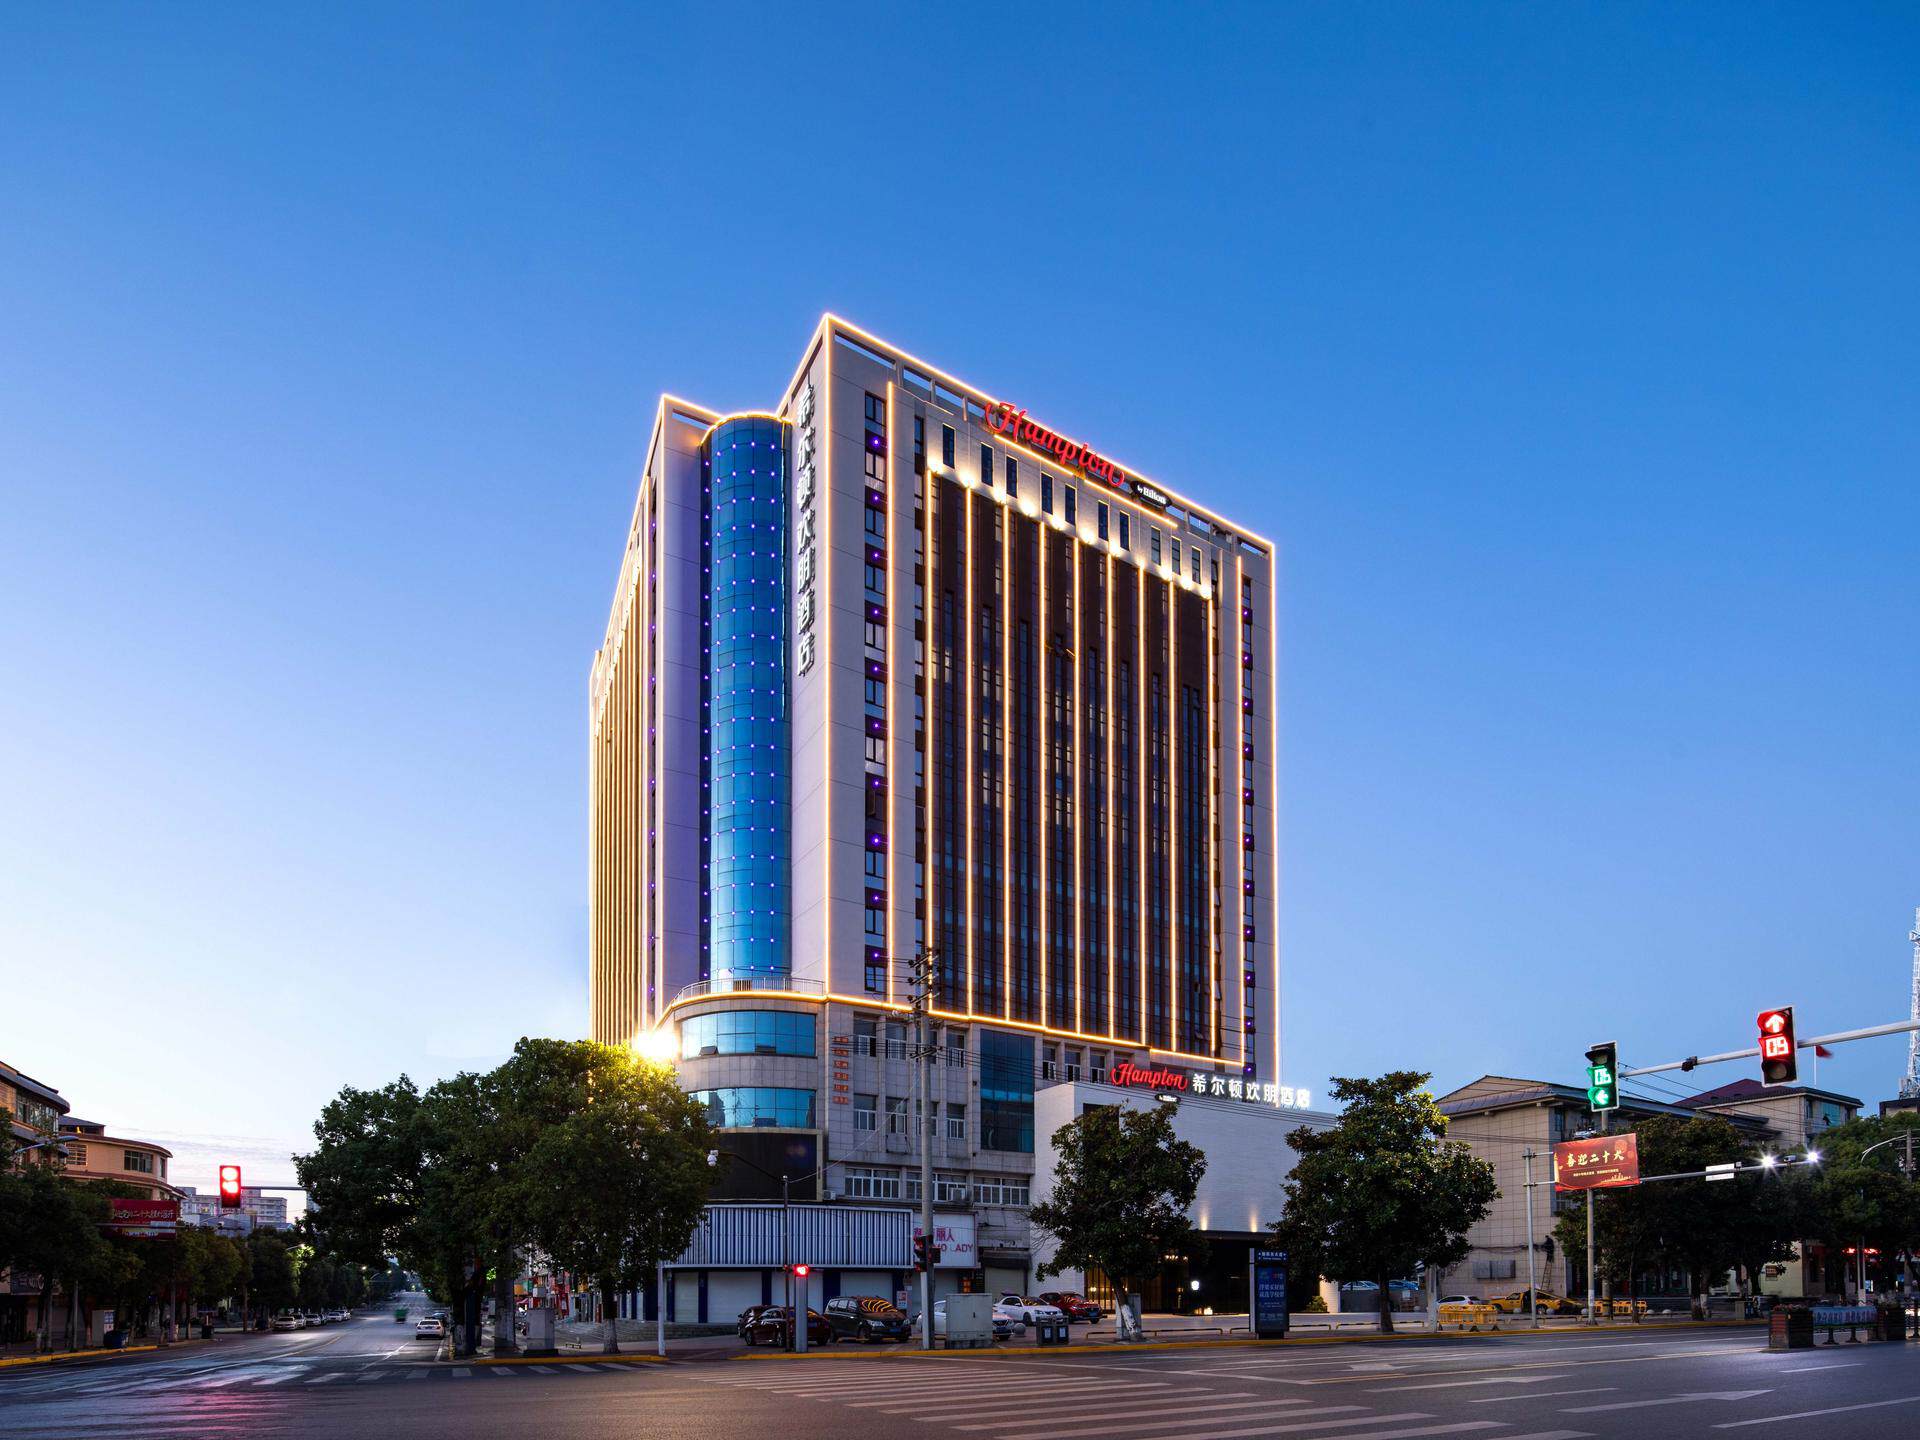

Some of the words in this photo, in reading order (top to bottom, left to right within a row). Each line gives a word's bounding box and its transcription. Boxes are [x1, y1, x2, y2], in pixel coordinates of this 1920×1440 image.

[985, 402, 1125, 488] Hampton
[1143, 486, 1167, 504] Hilton
[797, 385, 815, 677] 希尔顿欢朋酒店
[1765, 1036, 1789, 1057] 09
[1110, 1063, 1189, 1091] Hampton
[1192, 1073, 1311, 1108] 希尔顿欢朋酒店
[1566, 1149, 1625, 1168] 喜迎二十大
